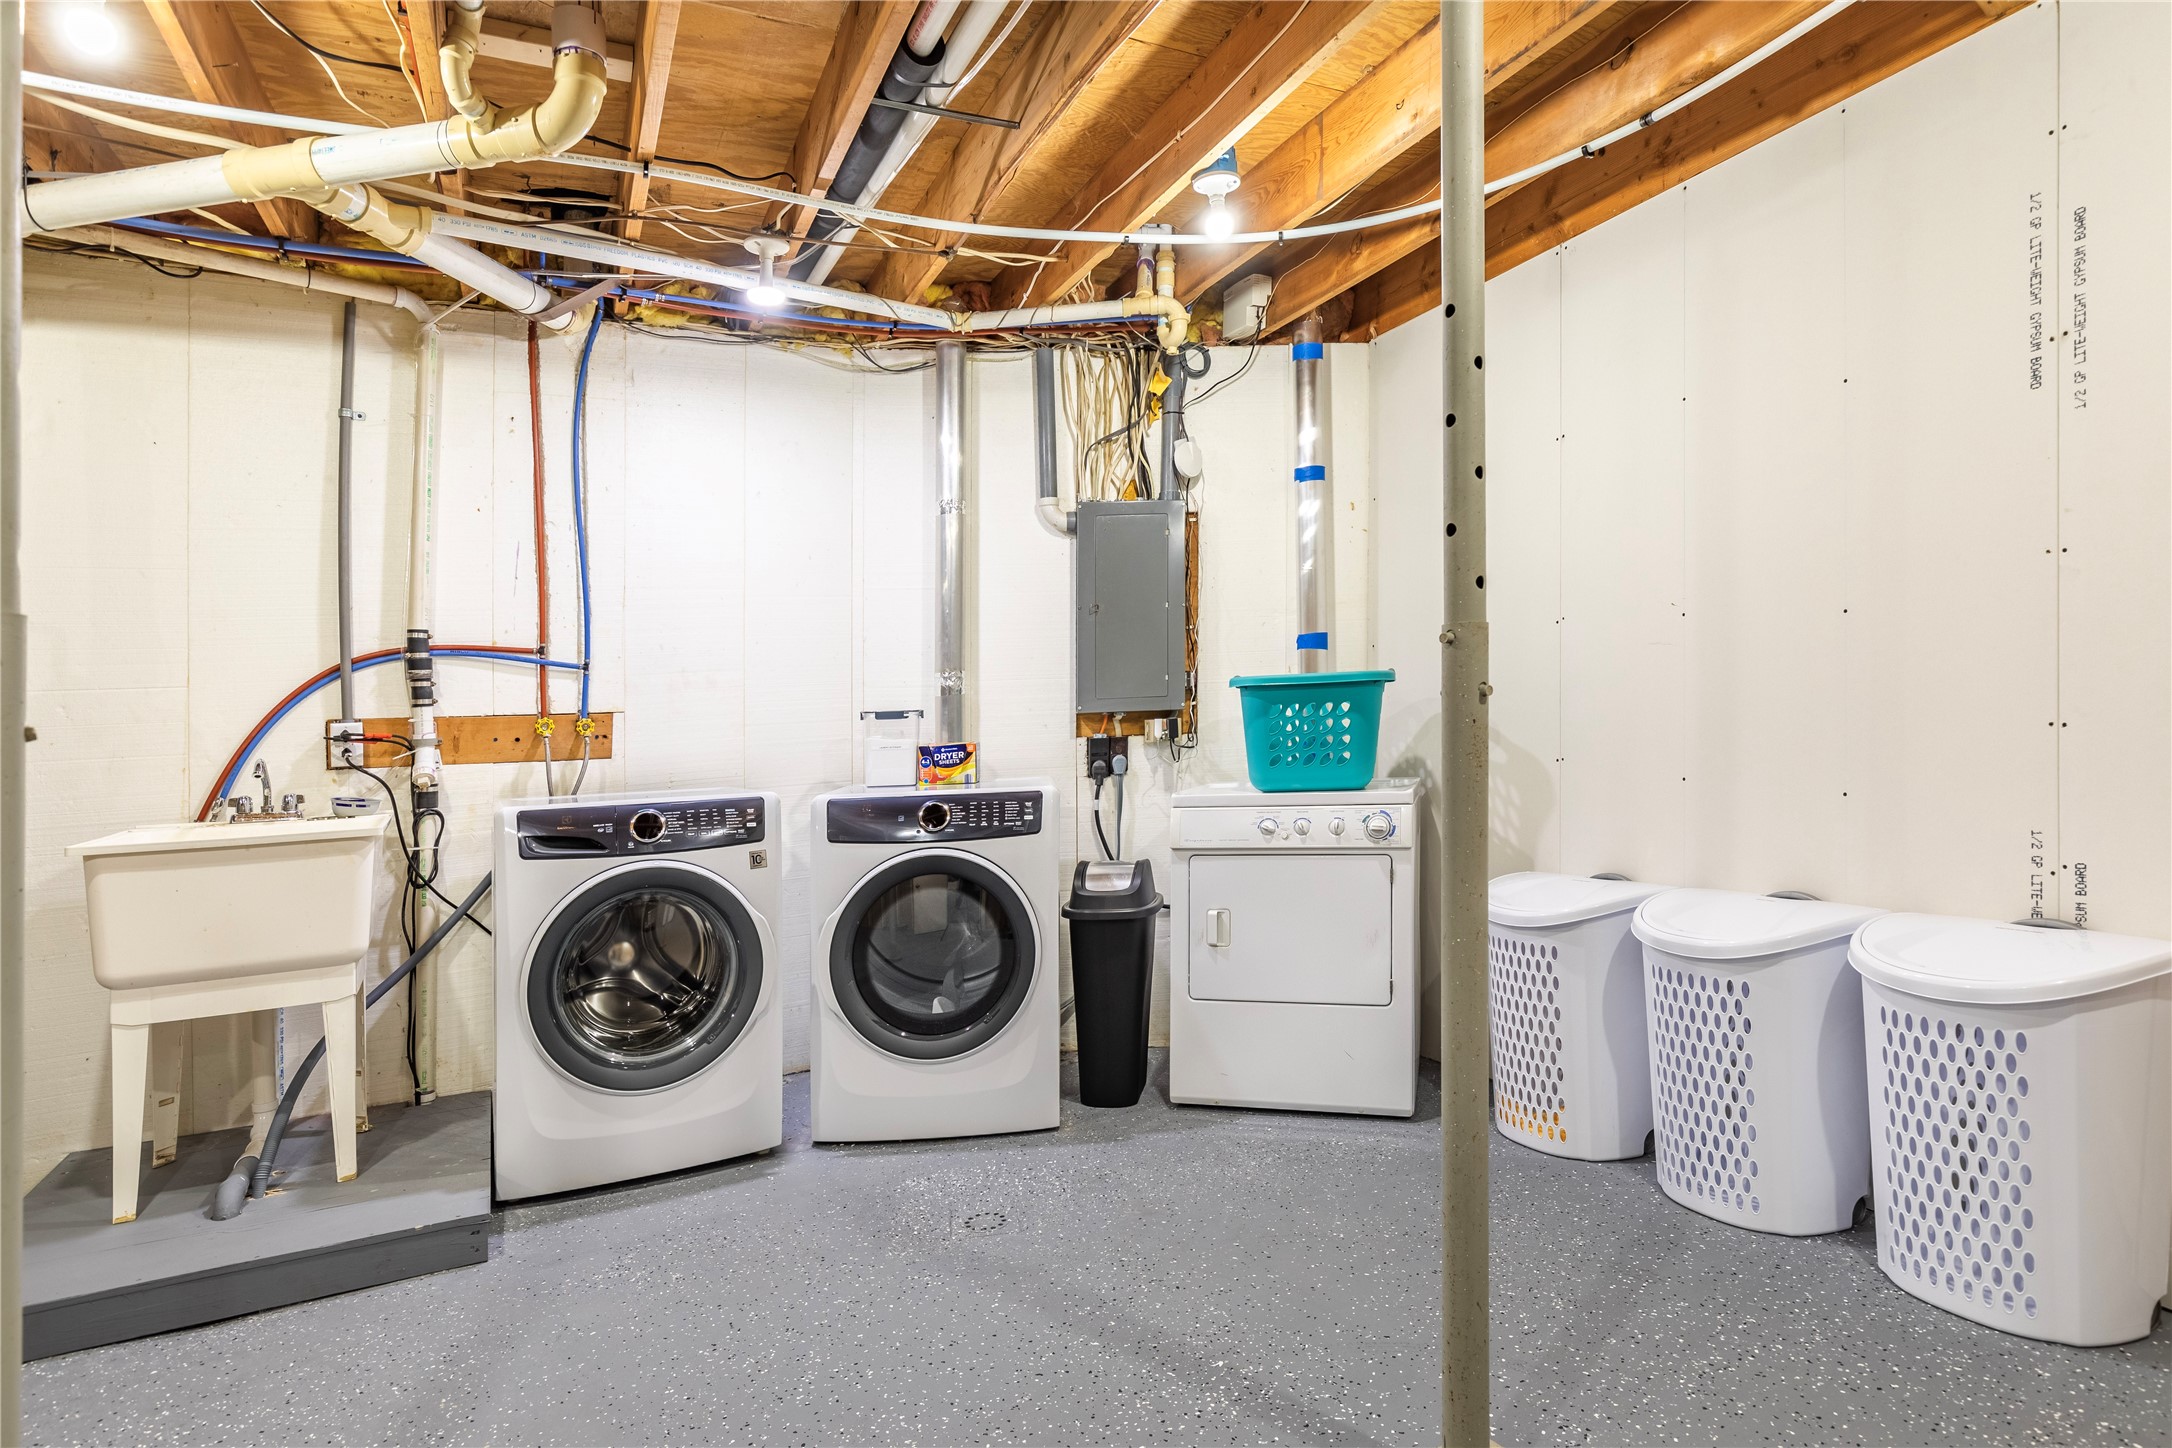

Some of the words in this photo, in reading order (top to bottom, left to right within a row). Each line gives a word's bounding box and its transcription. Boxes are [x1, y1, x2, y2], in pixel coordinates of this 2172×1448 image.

[2029, 192, 2042, 213] 1/2
[2029, 216, 2042, 230] GP
[2073, 206, 2087, 242] BOARD
[2029, 235, 2043, 306] LITE-WEIGHT
[2073, 244, 2087, 287] GYPSUM
[2029, 312, 2043, 353] GYPSUM
[2073, 292, 2087, 366] LITE-WEIGHT
[2029, 355, 2043, 391] BOARD
[2073, 370, 2087, 384] GP
[2073, 388, 2087, 409] 1/2
[935, 752, 964, 760] DRYER
[2030, 829, 2043, 850] 1/2
[2030, 855, 2043, 869] GP
[2075, 863, 2087, 896] BOARD
